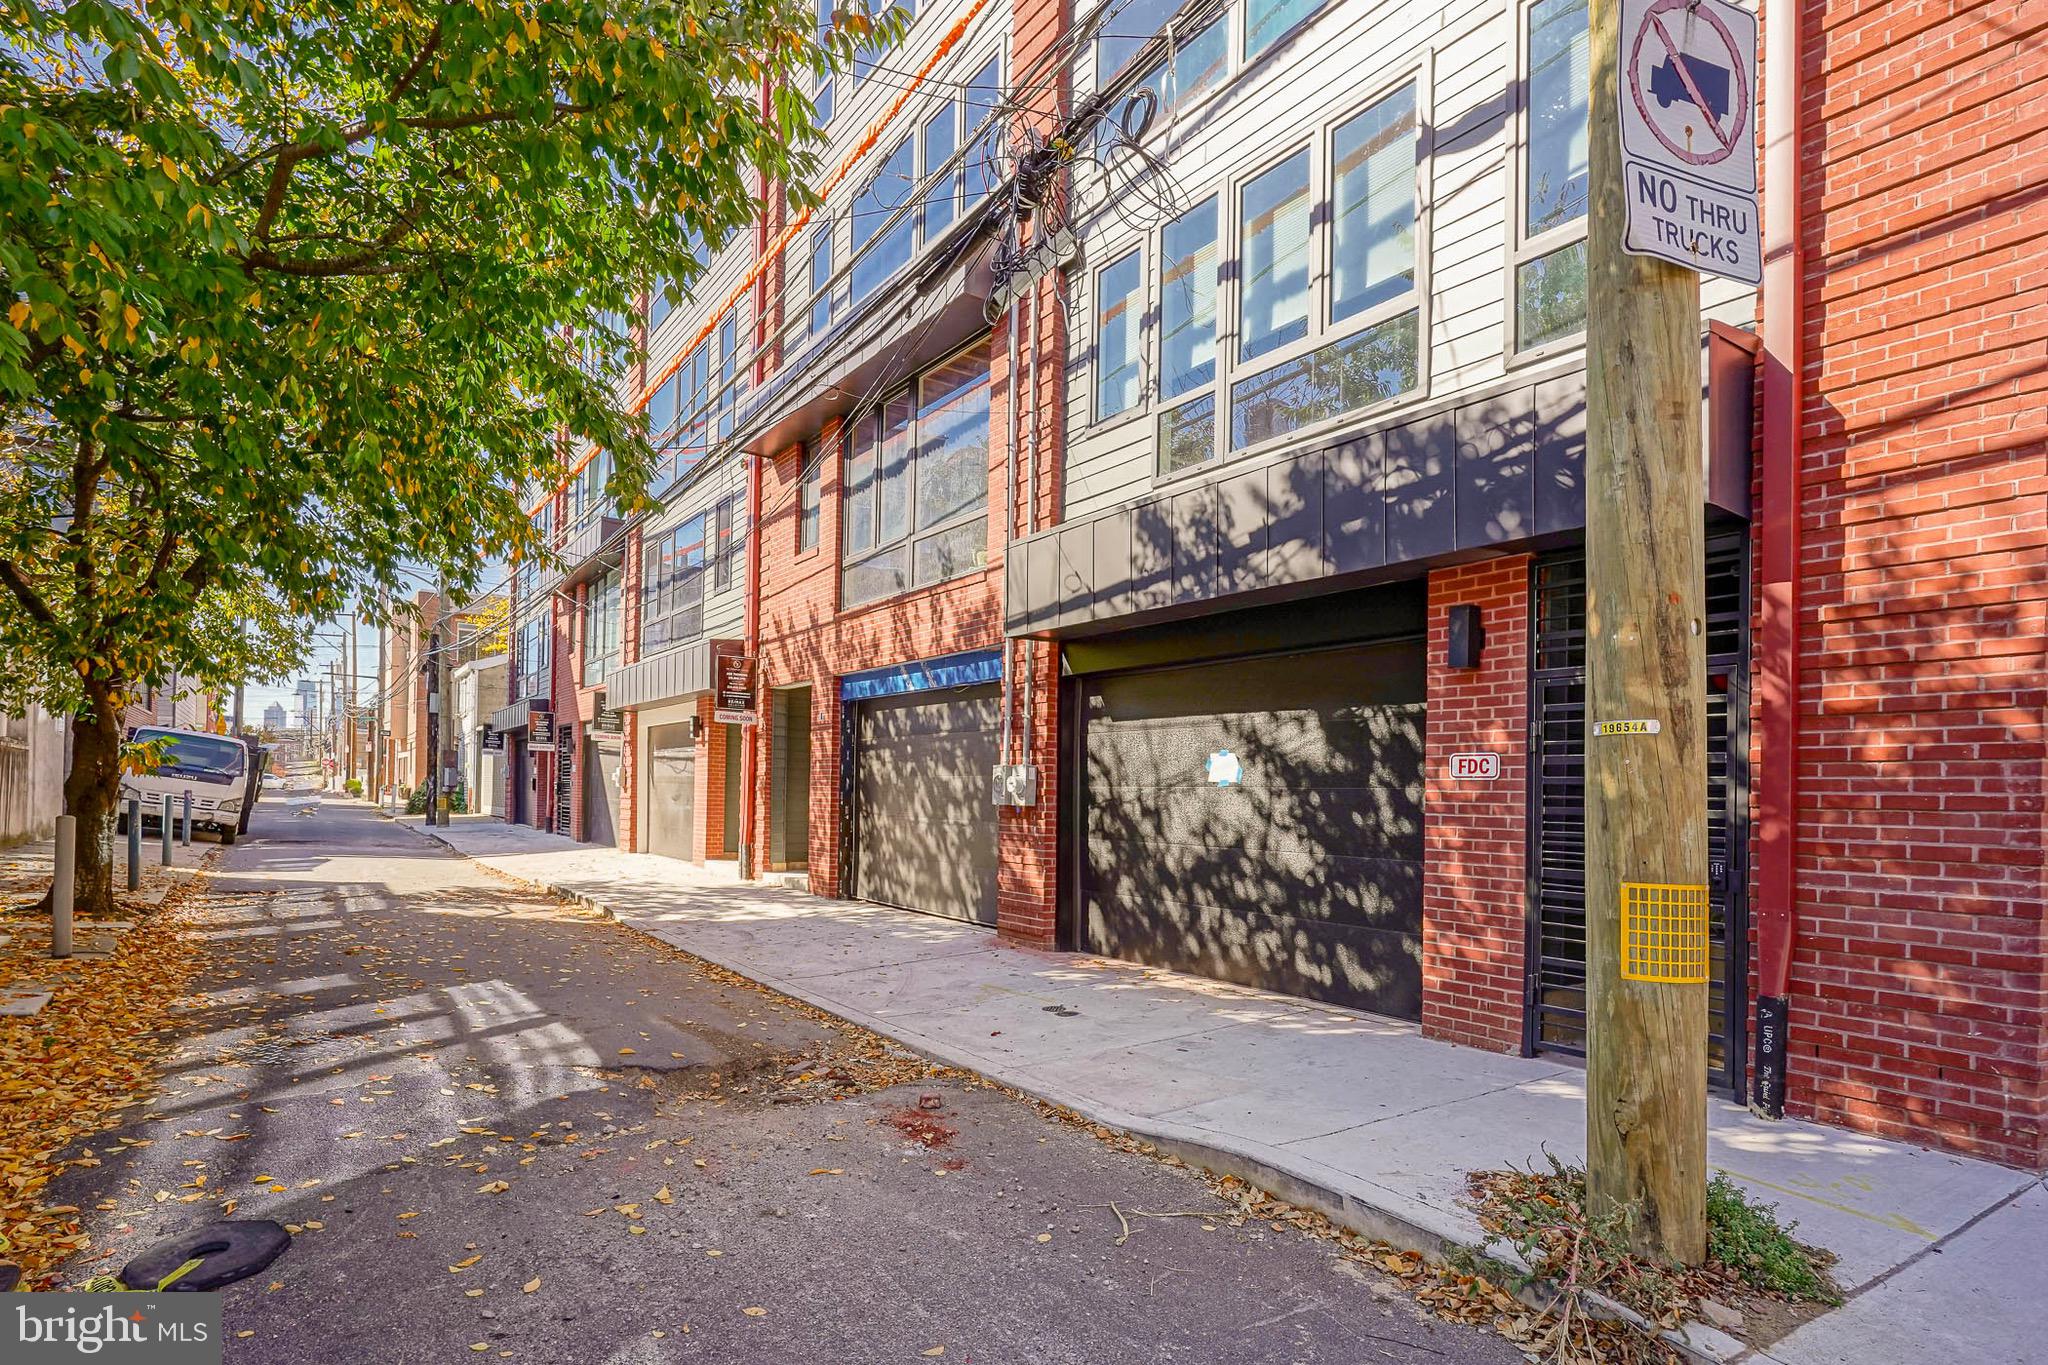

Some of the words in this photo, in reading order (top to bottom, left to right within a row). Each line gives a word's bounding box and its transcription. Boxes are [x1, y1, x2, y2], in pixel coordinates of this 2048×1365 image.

[1638, 171, 1677, 213] NO
[1685, 194, 1748, 235] THRU
[1652, 216, 1739, 265] TRUCKS
[719, 713, 739, 721] COMING
[1603, 722, 1647, 733] 19654A
[1458, 758, 1490, 775] FDC
